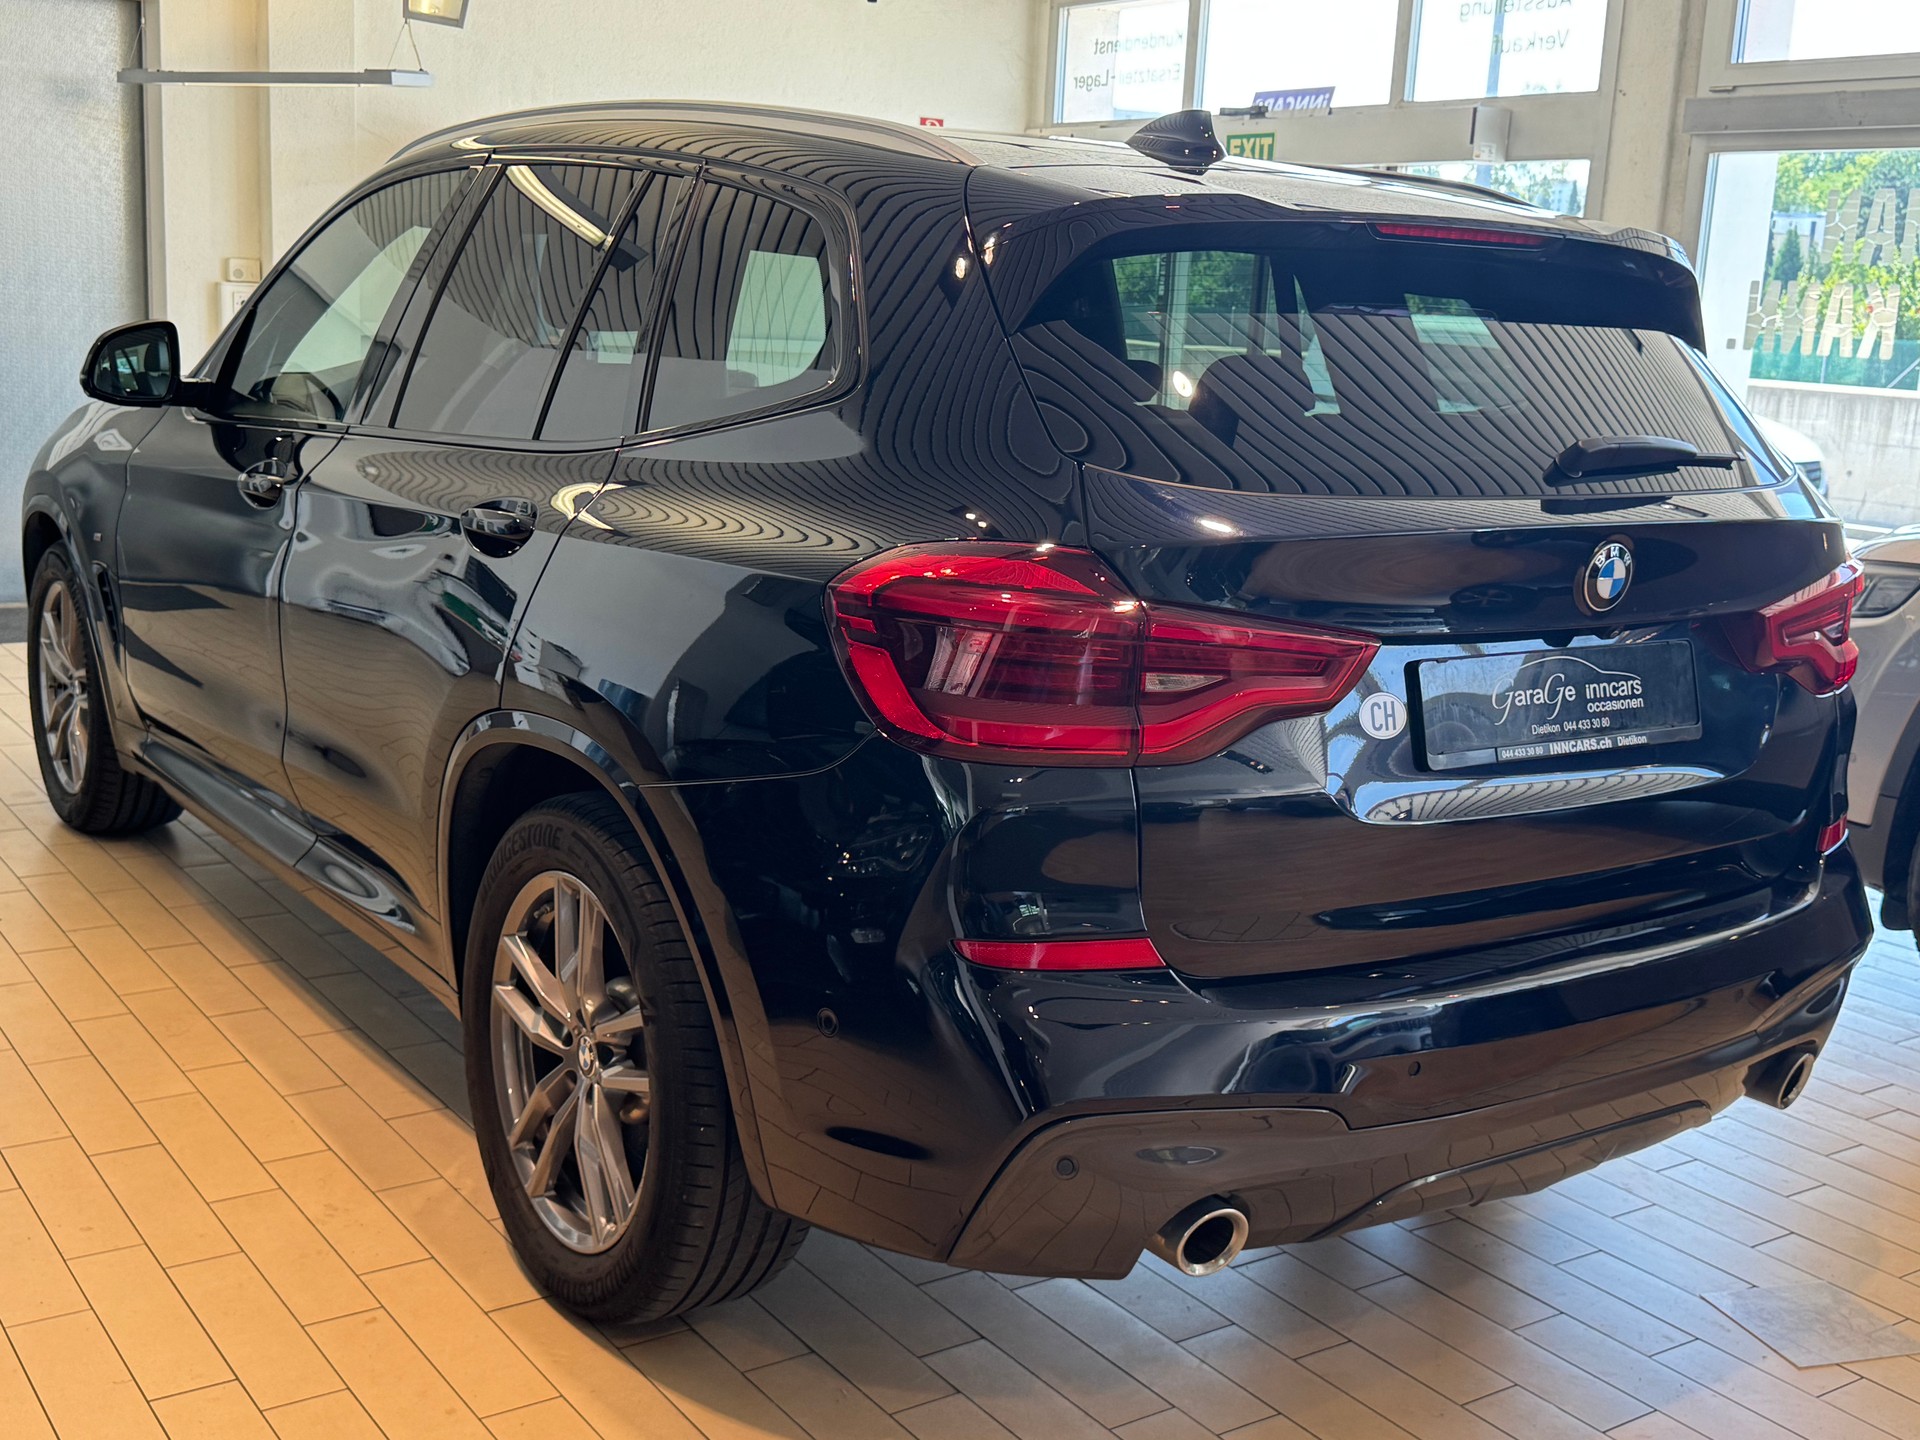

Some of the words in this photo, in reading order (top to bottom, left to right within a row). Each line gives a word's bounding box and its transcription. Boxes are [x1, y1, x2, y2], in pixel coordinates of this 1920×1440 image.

[1230, 137, 1273, 160] EXIT
[1594, 546, 1632, 569] BMW
[1585, 679, 1643, 700] inncars
[1370, 701, 1397, 733] CH
[1586, 698, 1644, 713] occasionen
[1531, 723, 1561, 735] Dietikon
[1563, 720, 1577, 731] 044
[1578, 719, 1591, 730] 433
[1591, 718, 1600, 729] 30
[1601, 717, 1610, 727] 80
[1501, 749, 1514, 759] 044
[1514, 748, 1526, 757] 433
[1526, 747, 1535, 756] 30
[1535, 746, 1543, 755] 80
[1549, 737, 1613, 755] INNCARS.ch
[1617, 734, 1648, 746] Dietikon
